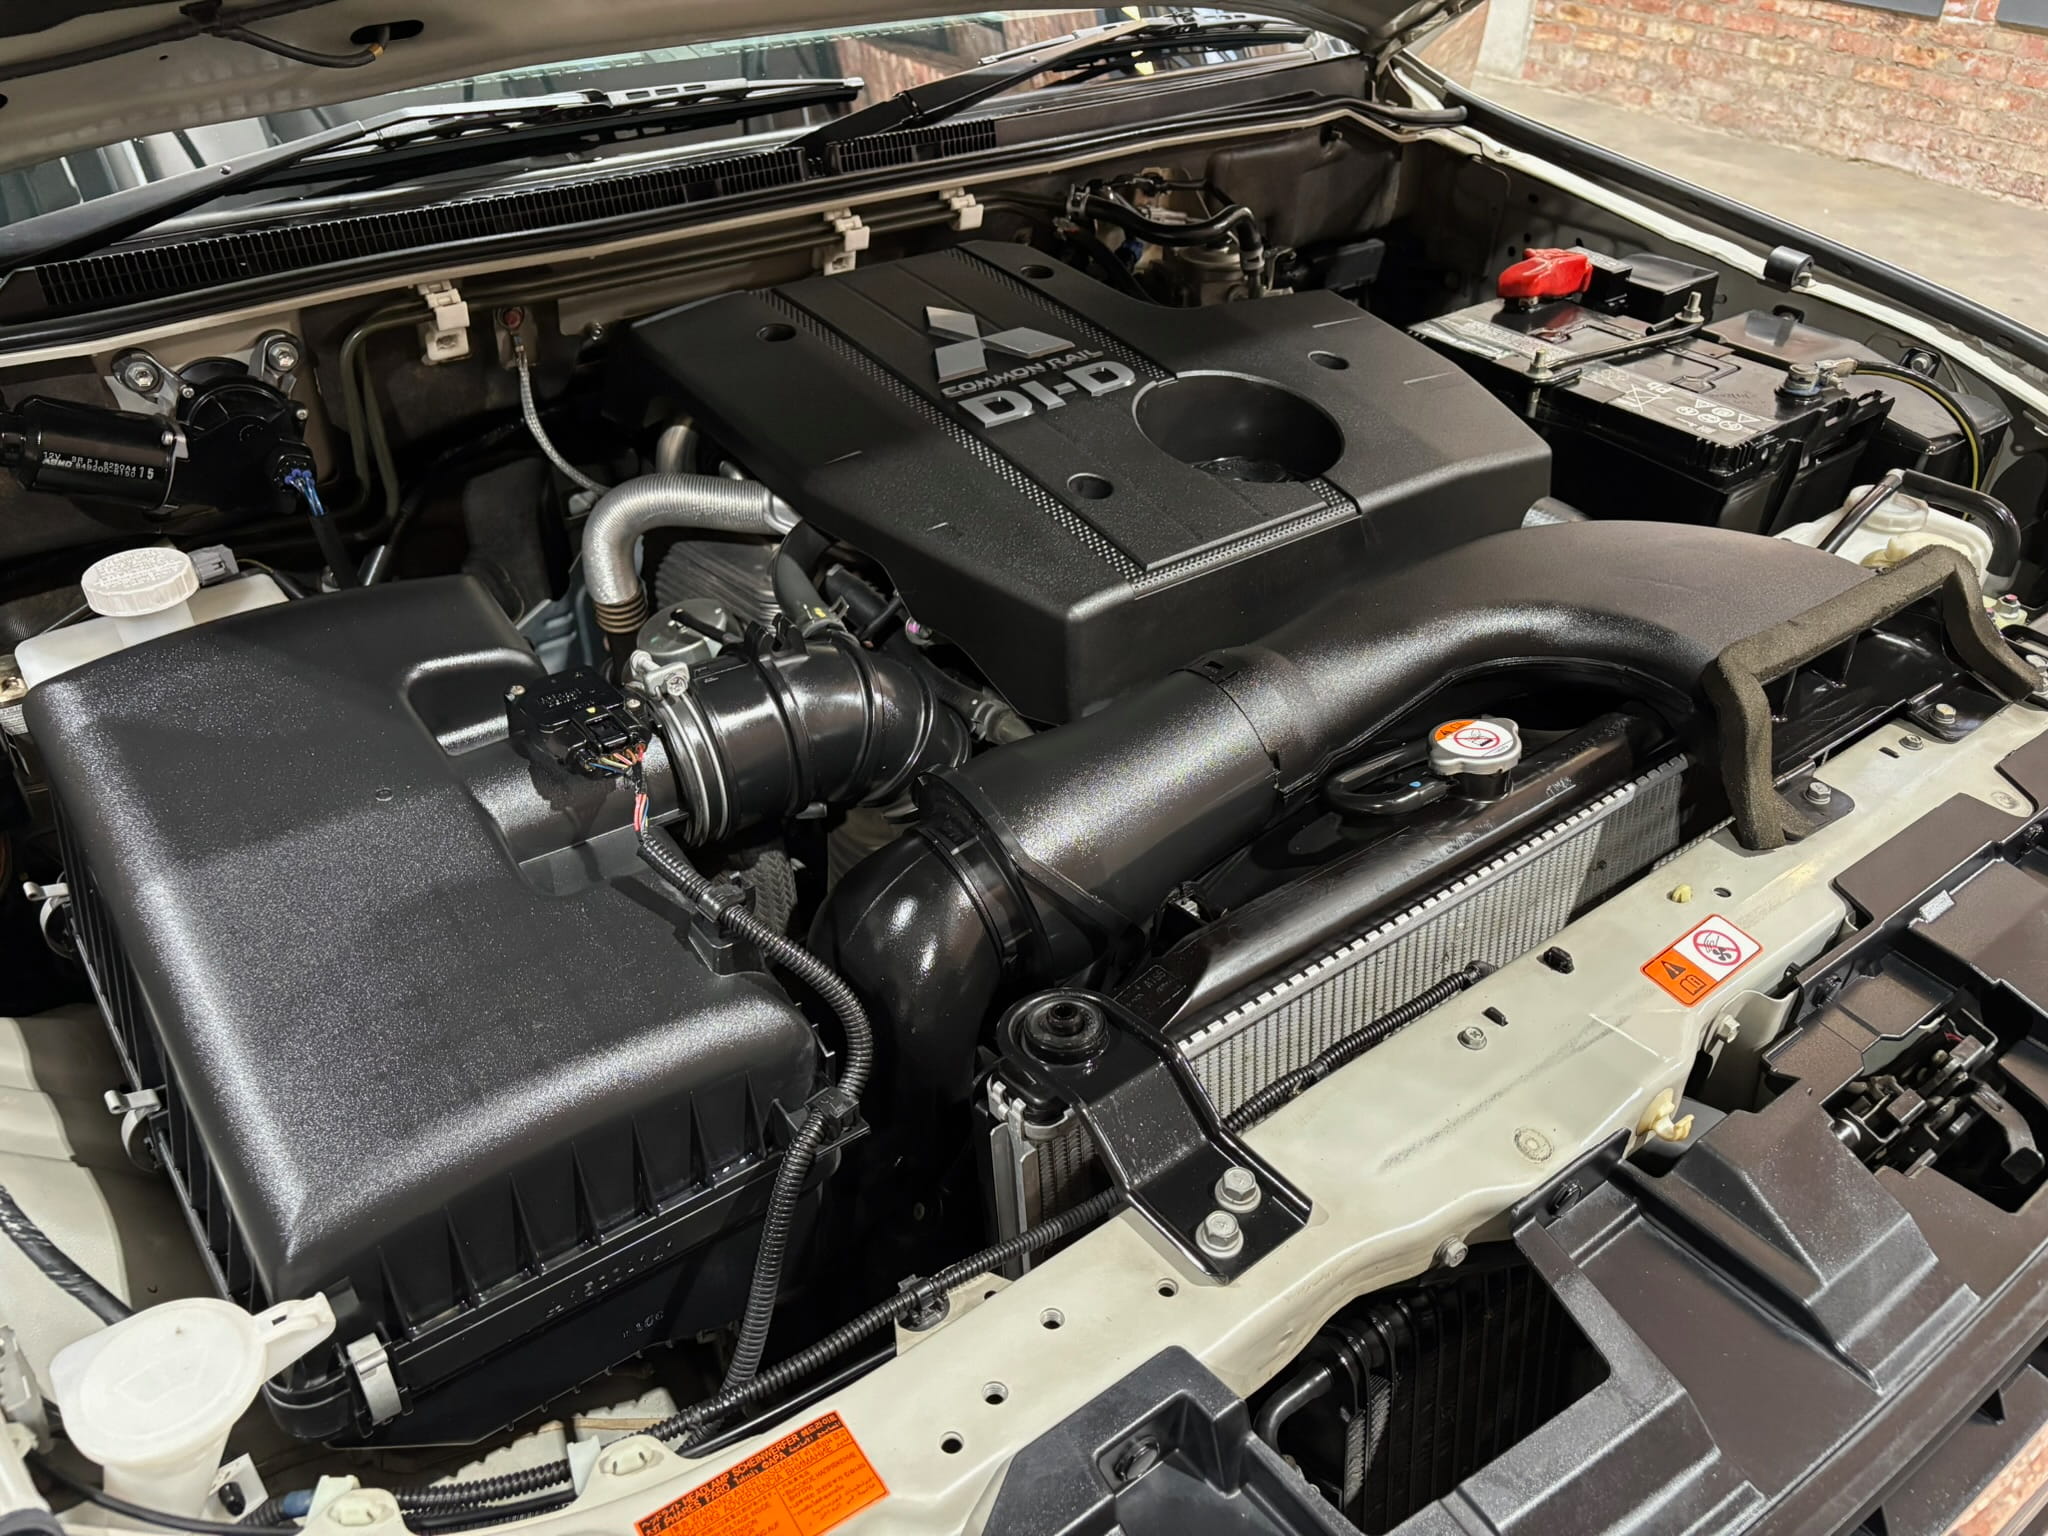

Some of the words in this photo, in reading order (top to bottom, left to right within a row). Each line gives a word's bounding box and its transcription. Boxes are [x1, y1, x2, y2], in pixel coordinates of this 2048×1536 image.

[941, 362, 1046, 398] COMMON
[1046, 350, 1104, 370] RAIL
[958, 361, 1136, 429] DI-D
[680, 1472, 731, 1505] HEADLAMP
[730, 1433, 800, 1476] SCHEINWERFER
[689, 1492, 733, 1522] WARNING
[731, 1452, 803, 1497] AVERTISSEMENT
[721, 1472, 784, 1513] ADVERTENCIA
[661, 1499, 702, 1526] PHARES
[703, 1482, 731, 1502] FARO
